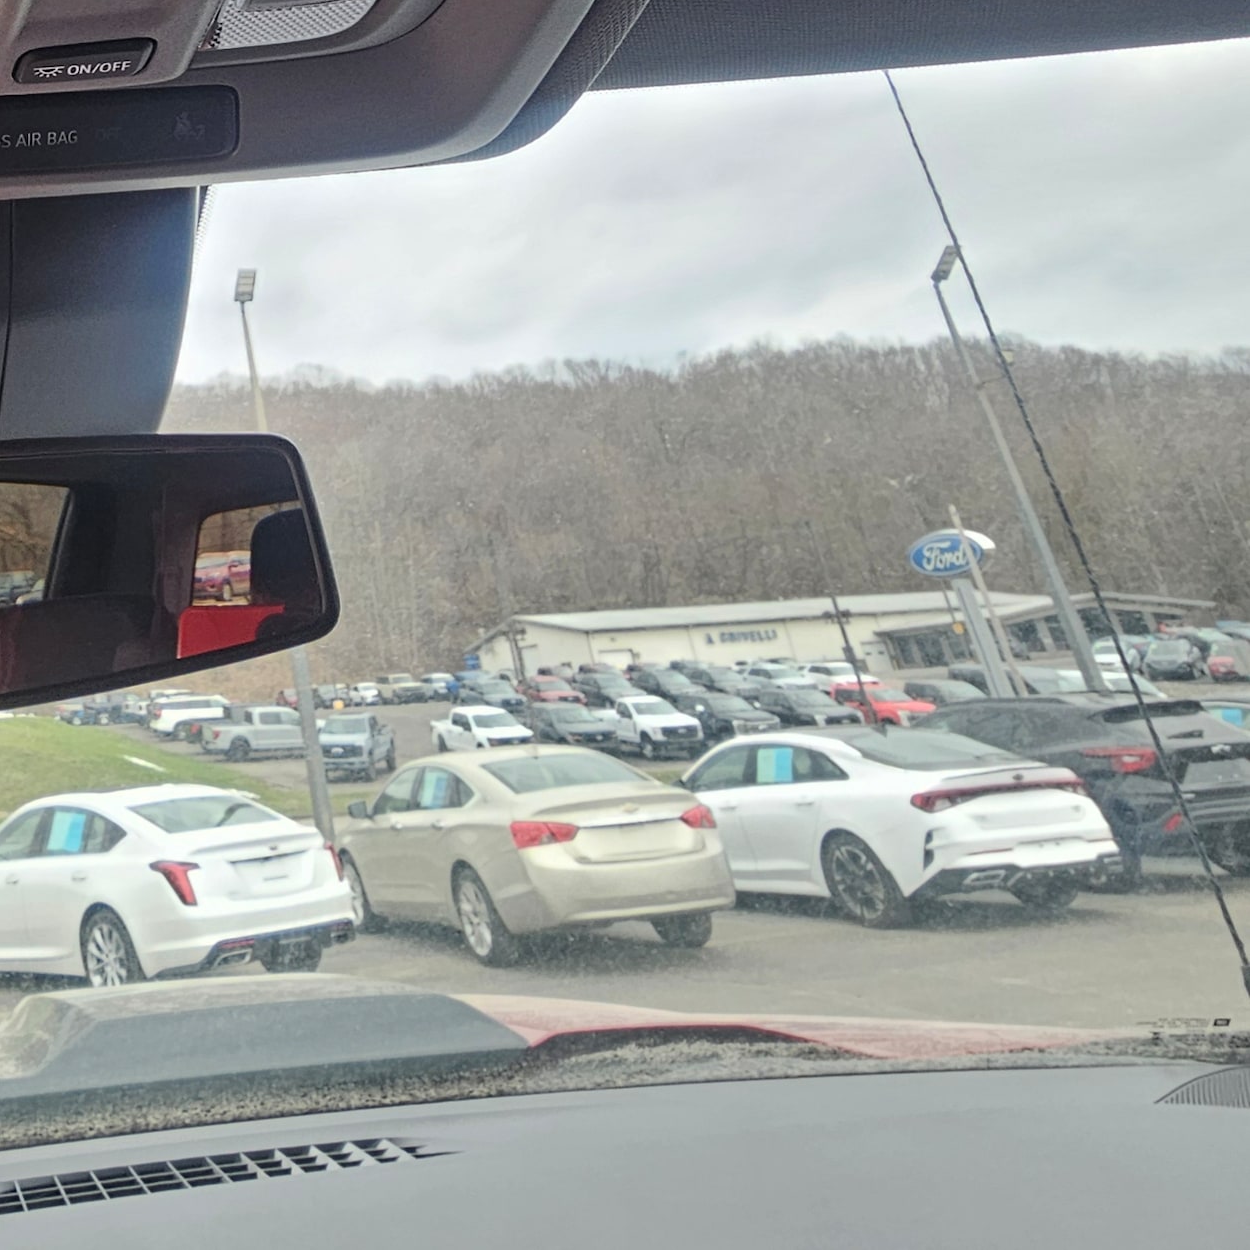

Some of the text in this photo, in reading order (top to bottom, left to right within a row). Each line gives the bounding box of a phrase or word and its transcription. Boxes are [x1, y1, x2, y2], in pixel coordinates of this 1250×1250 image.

[67, 60, 131, 76] ON/OFF
[15, 132, 42, 148] AIR
[47, 130, 78, 146] BAG
[922, 541, 968, 571] Ford
